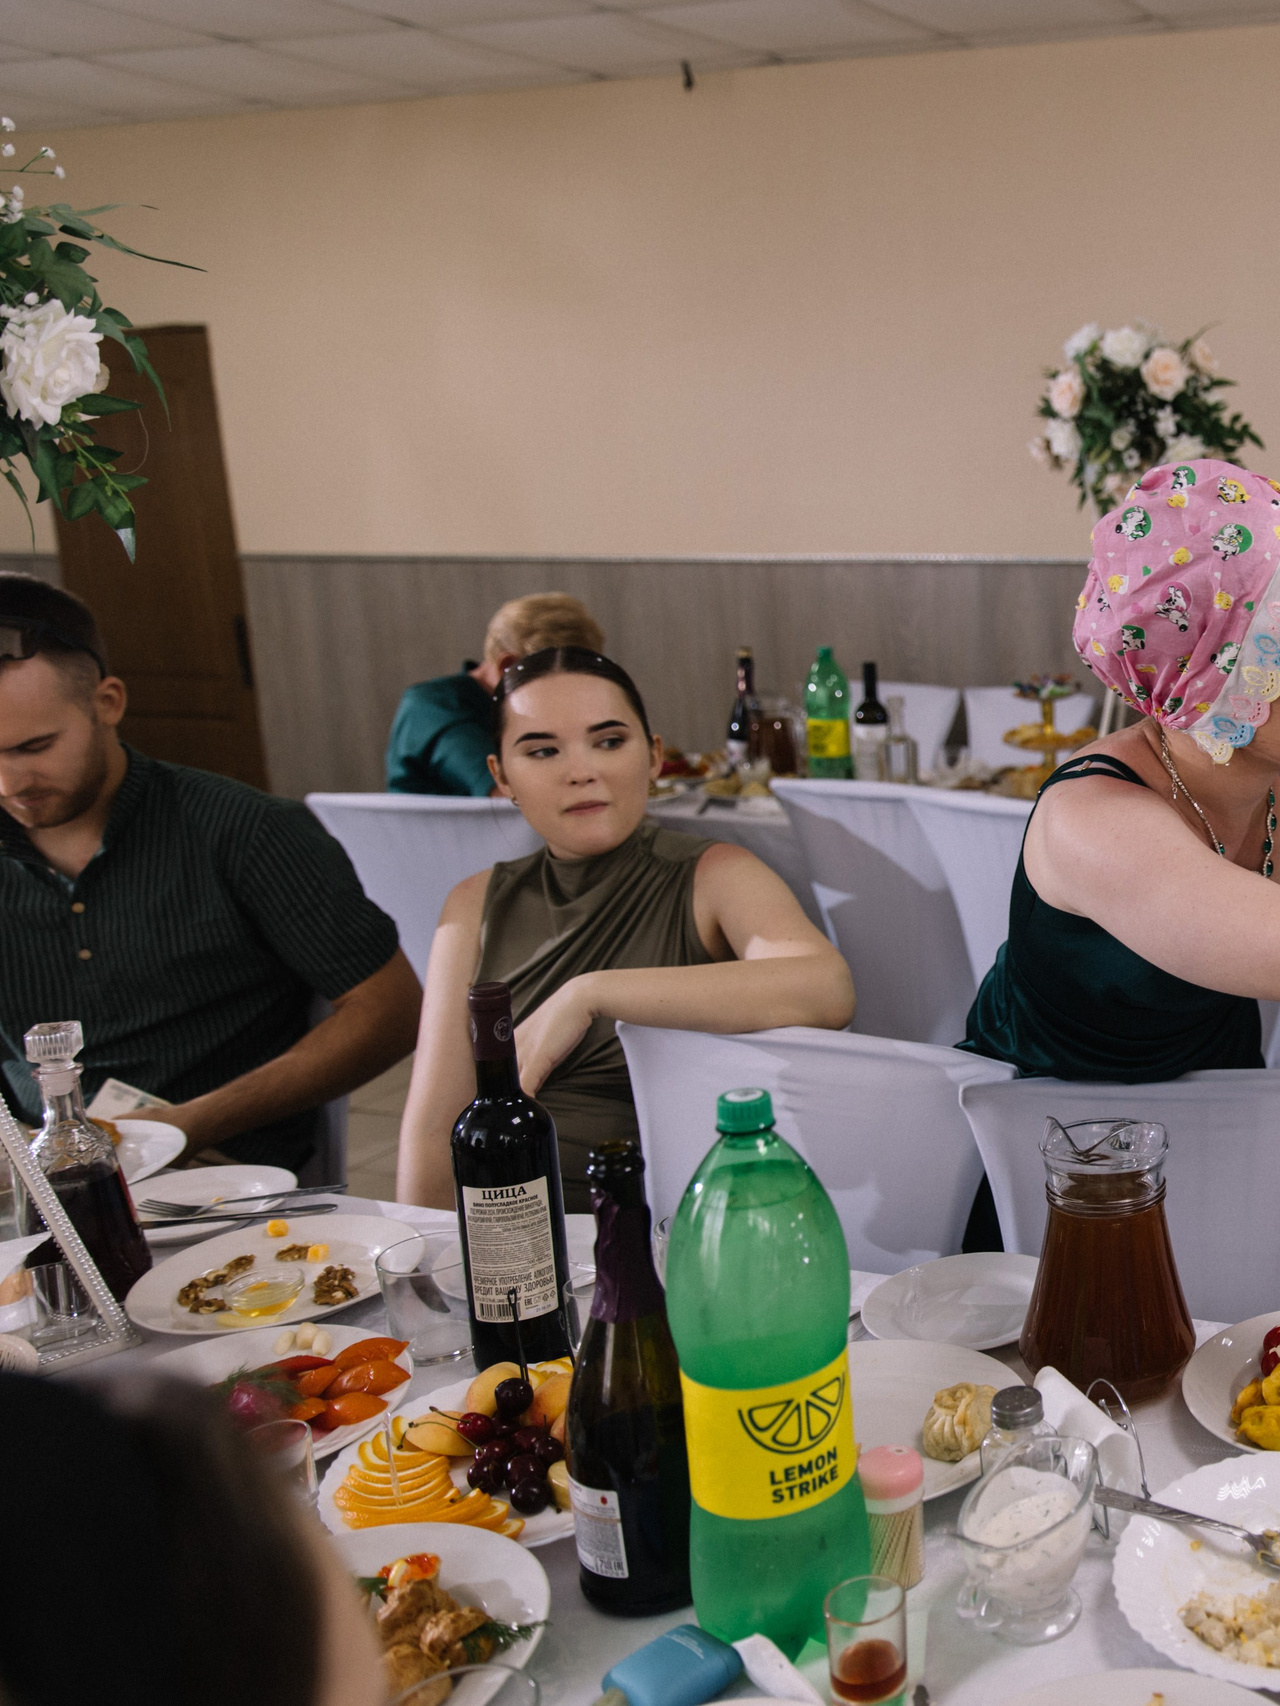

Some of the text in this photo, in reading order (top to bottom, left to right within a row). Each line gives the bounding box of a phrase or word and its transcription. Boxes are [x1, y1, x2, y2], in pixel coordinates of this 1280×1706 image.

[482, 1186, 527, 1201] ЦИЦА
[485, 1200, 518, 1208] ПОЛУСЛАДКОЕ
[519, 1194, 539, 1203] КРАСНОЕ
[474, 1284, 494, 1296] ВРЕДИТ
[523, 1274, 555, 1293] ЗДОРОВЬЮ
[499, 1272, 532, 1286] УПОТРЕБЛЕНИЕ
[769, 1446, 838, 1487] LEMON
[772, 1464, 839, 1504] STRIKE
